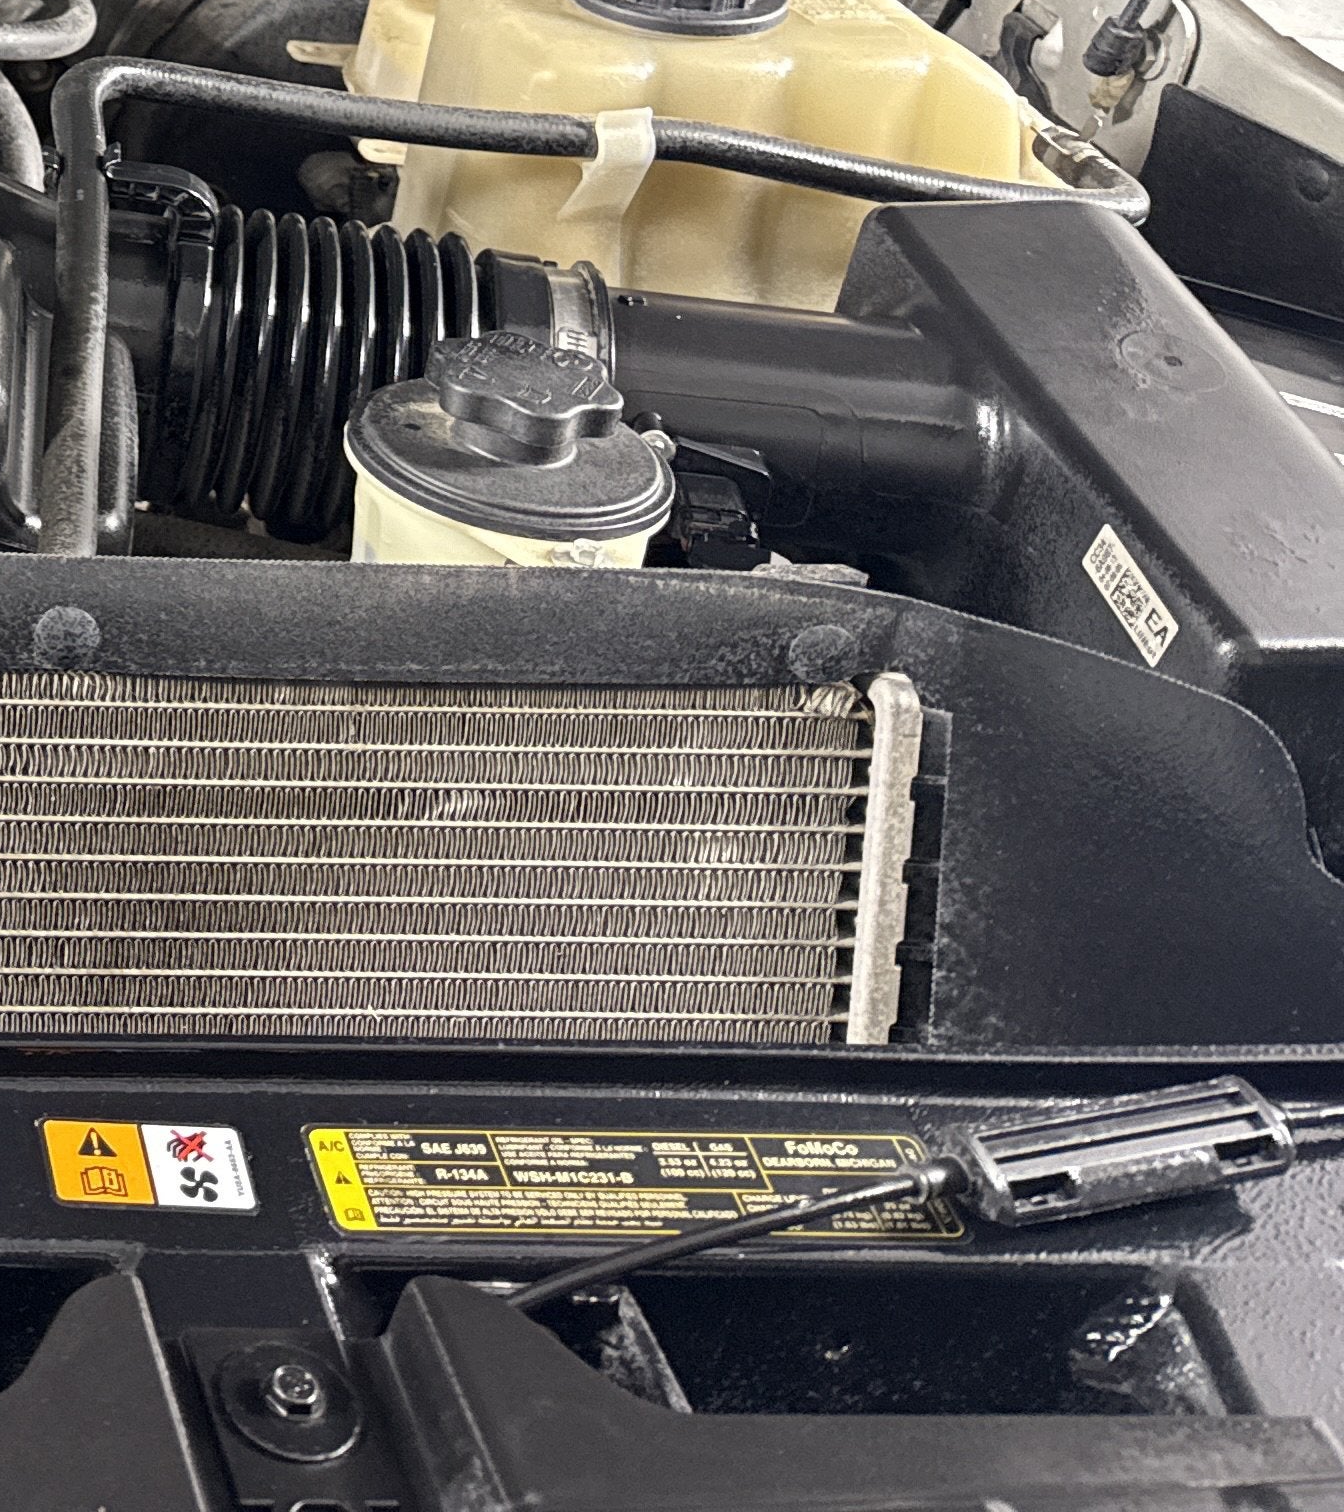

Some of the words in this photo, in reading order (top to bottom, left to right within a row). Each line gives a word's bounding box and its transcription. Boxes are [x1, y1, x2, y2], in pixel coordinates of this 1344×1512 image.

[319, 1140, 345, 1152] A/C
[421, 1143, 452, 1154] SAE
[783, 1140, 859, 1156] FoMoCo
[434, 1168, 489, 1181] R-134A
